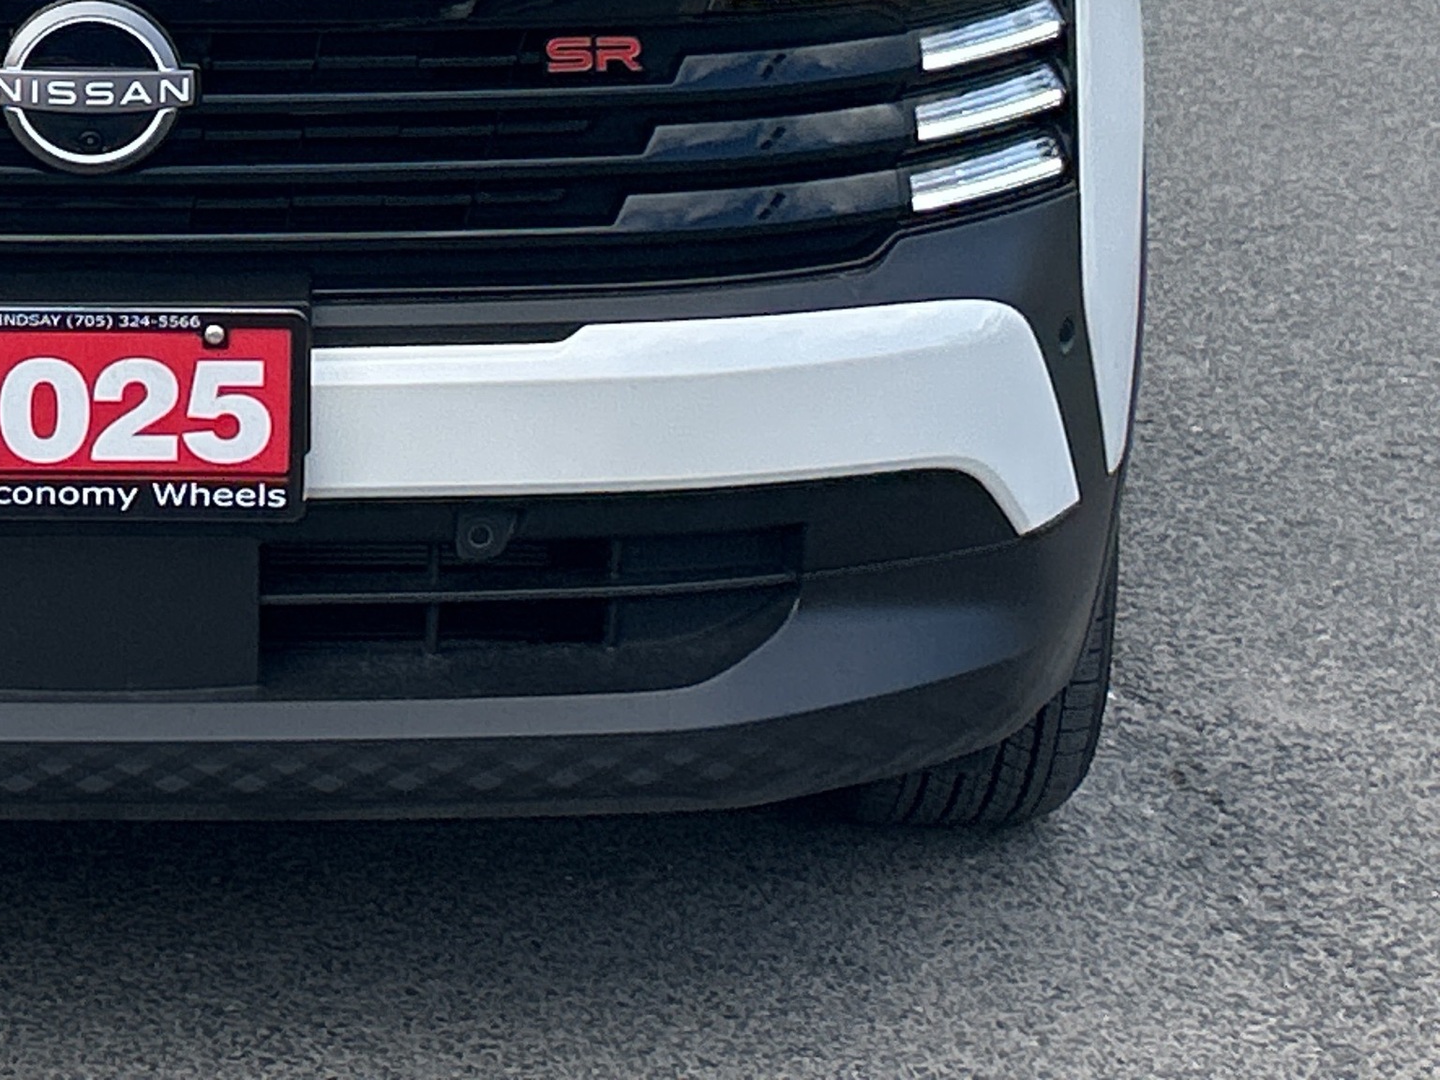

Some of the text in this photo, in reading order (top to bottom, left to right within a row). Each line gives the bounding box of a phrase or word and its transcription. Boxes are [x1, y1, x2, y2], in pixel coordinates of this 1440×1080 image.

[545, 36, 643, 74] SR
[66, 313, 113, 330] (705)
[118, 314, 201, 329] 324-5566
[152, 482, 288, 508] Wheels
